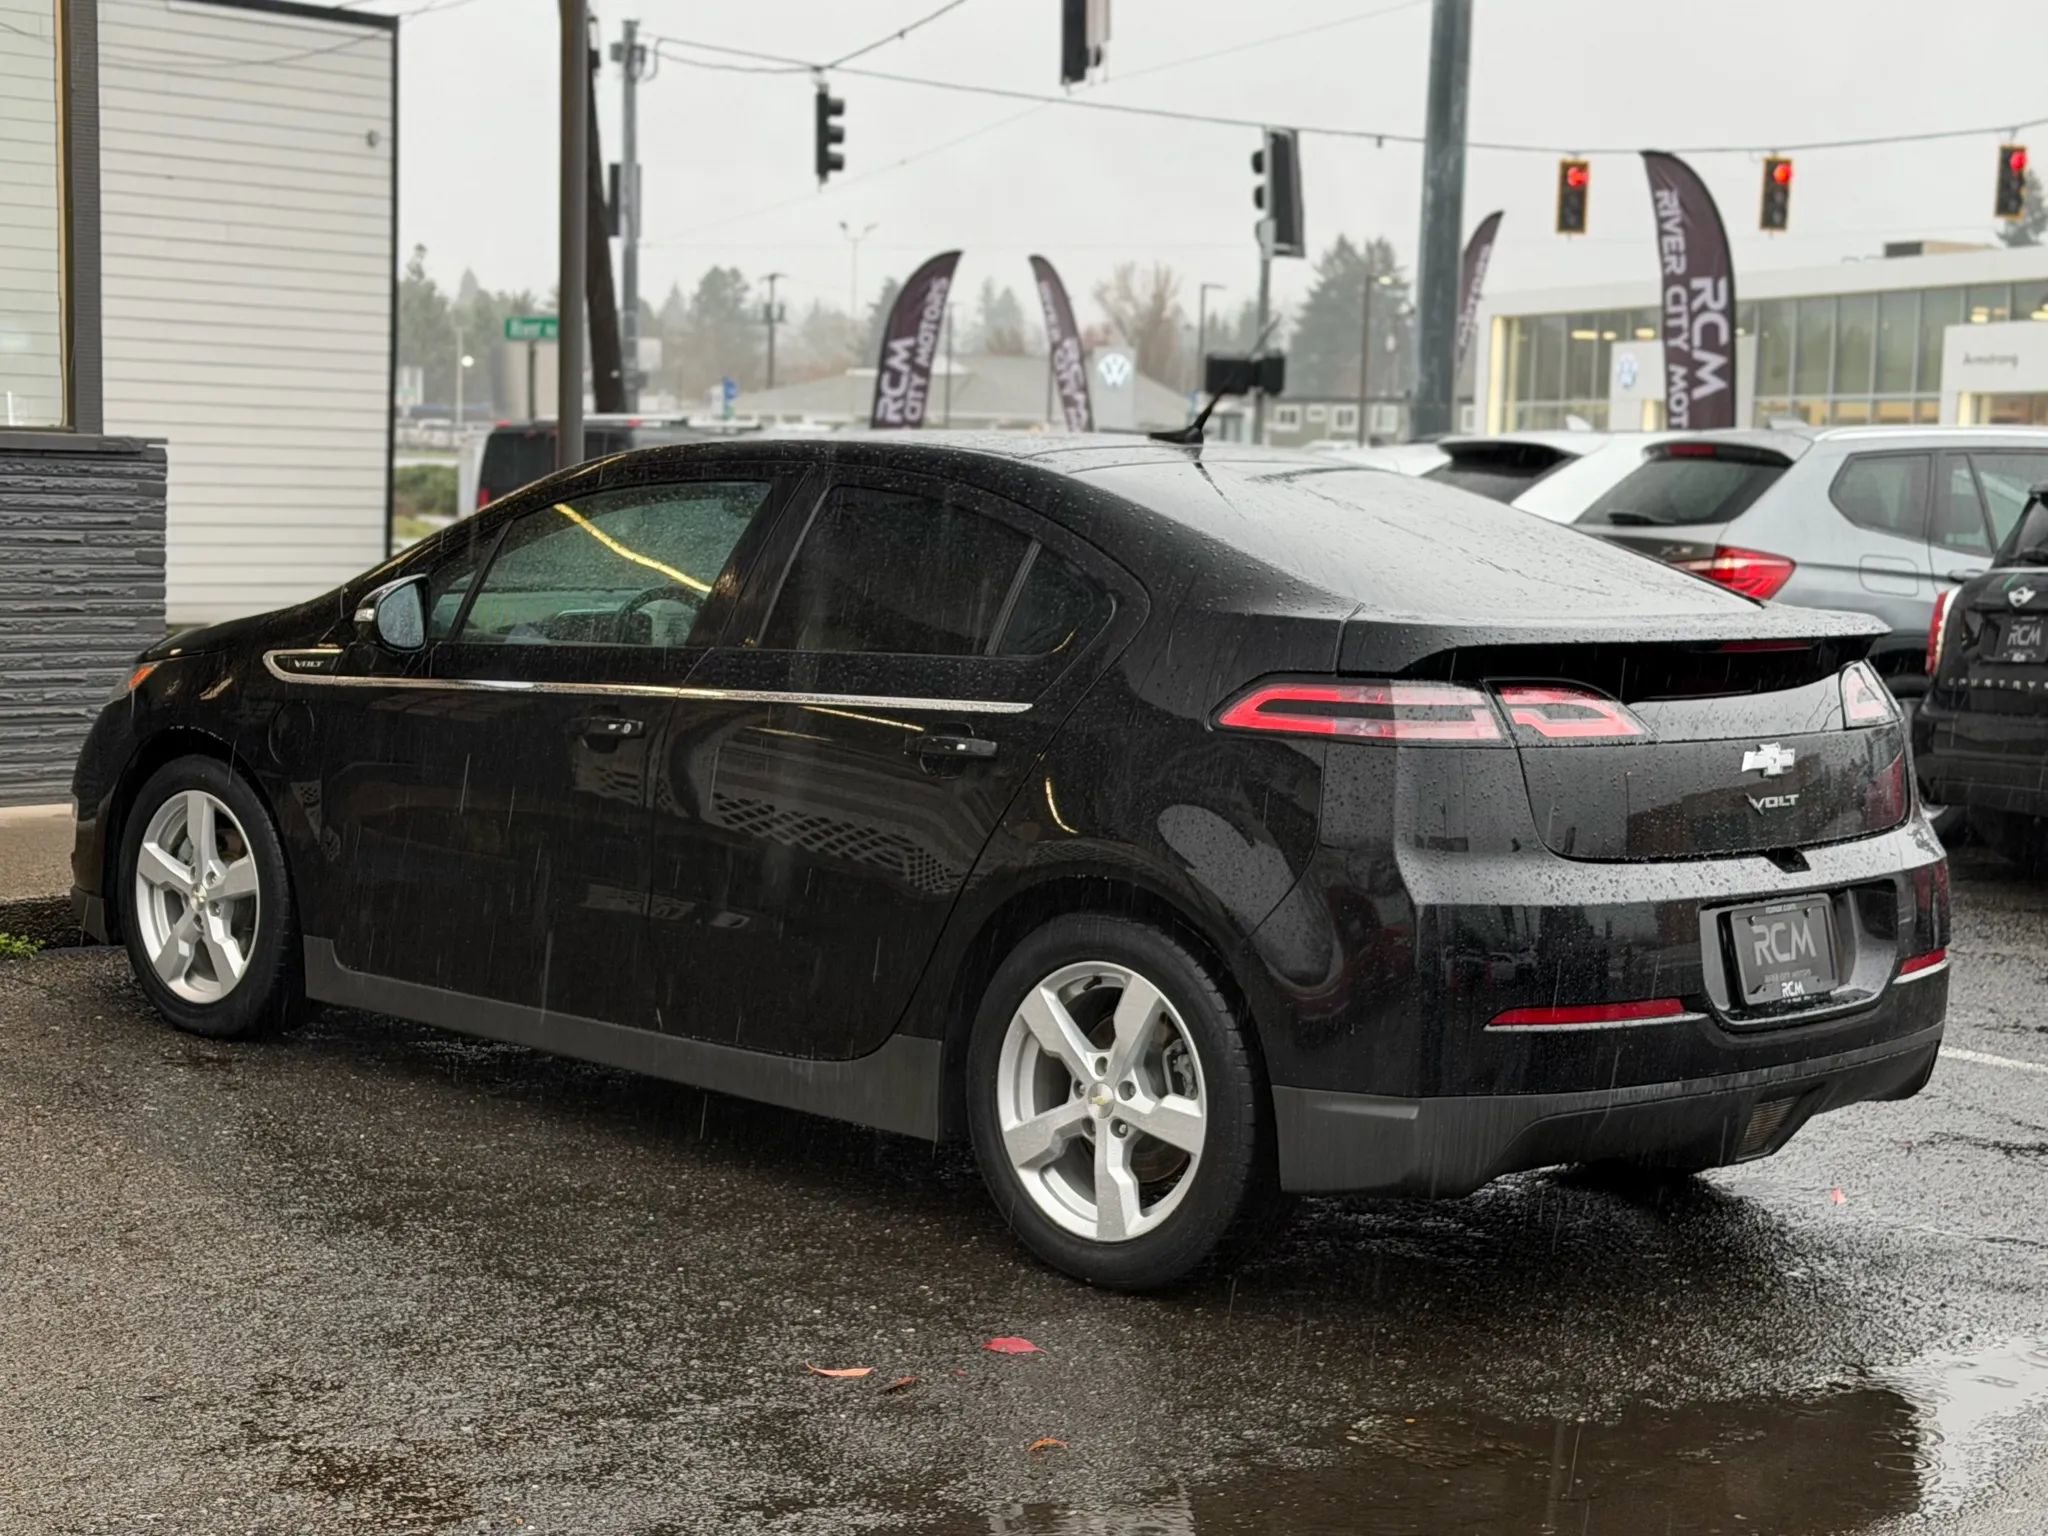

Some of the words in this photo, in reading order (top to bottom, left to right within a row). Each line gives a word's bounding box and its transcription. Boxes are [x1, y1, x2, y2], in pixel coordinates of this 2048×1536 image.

[1656, 189, 1687, 276] RIVER
[915, 277, 949, 367] MOTORS
[1665, 286, 1690, 352] CITY
[1690, 277, 1729, 400] RCM
[877, 336, 915, 423] RCM
[2007, 625, 2041, 646] RCM
[1745, 793, 1799, 815] VOLT
[1751, 920, 1816, 966] RCM
[1781, 981, 1805, 998] RCM
